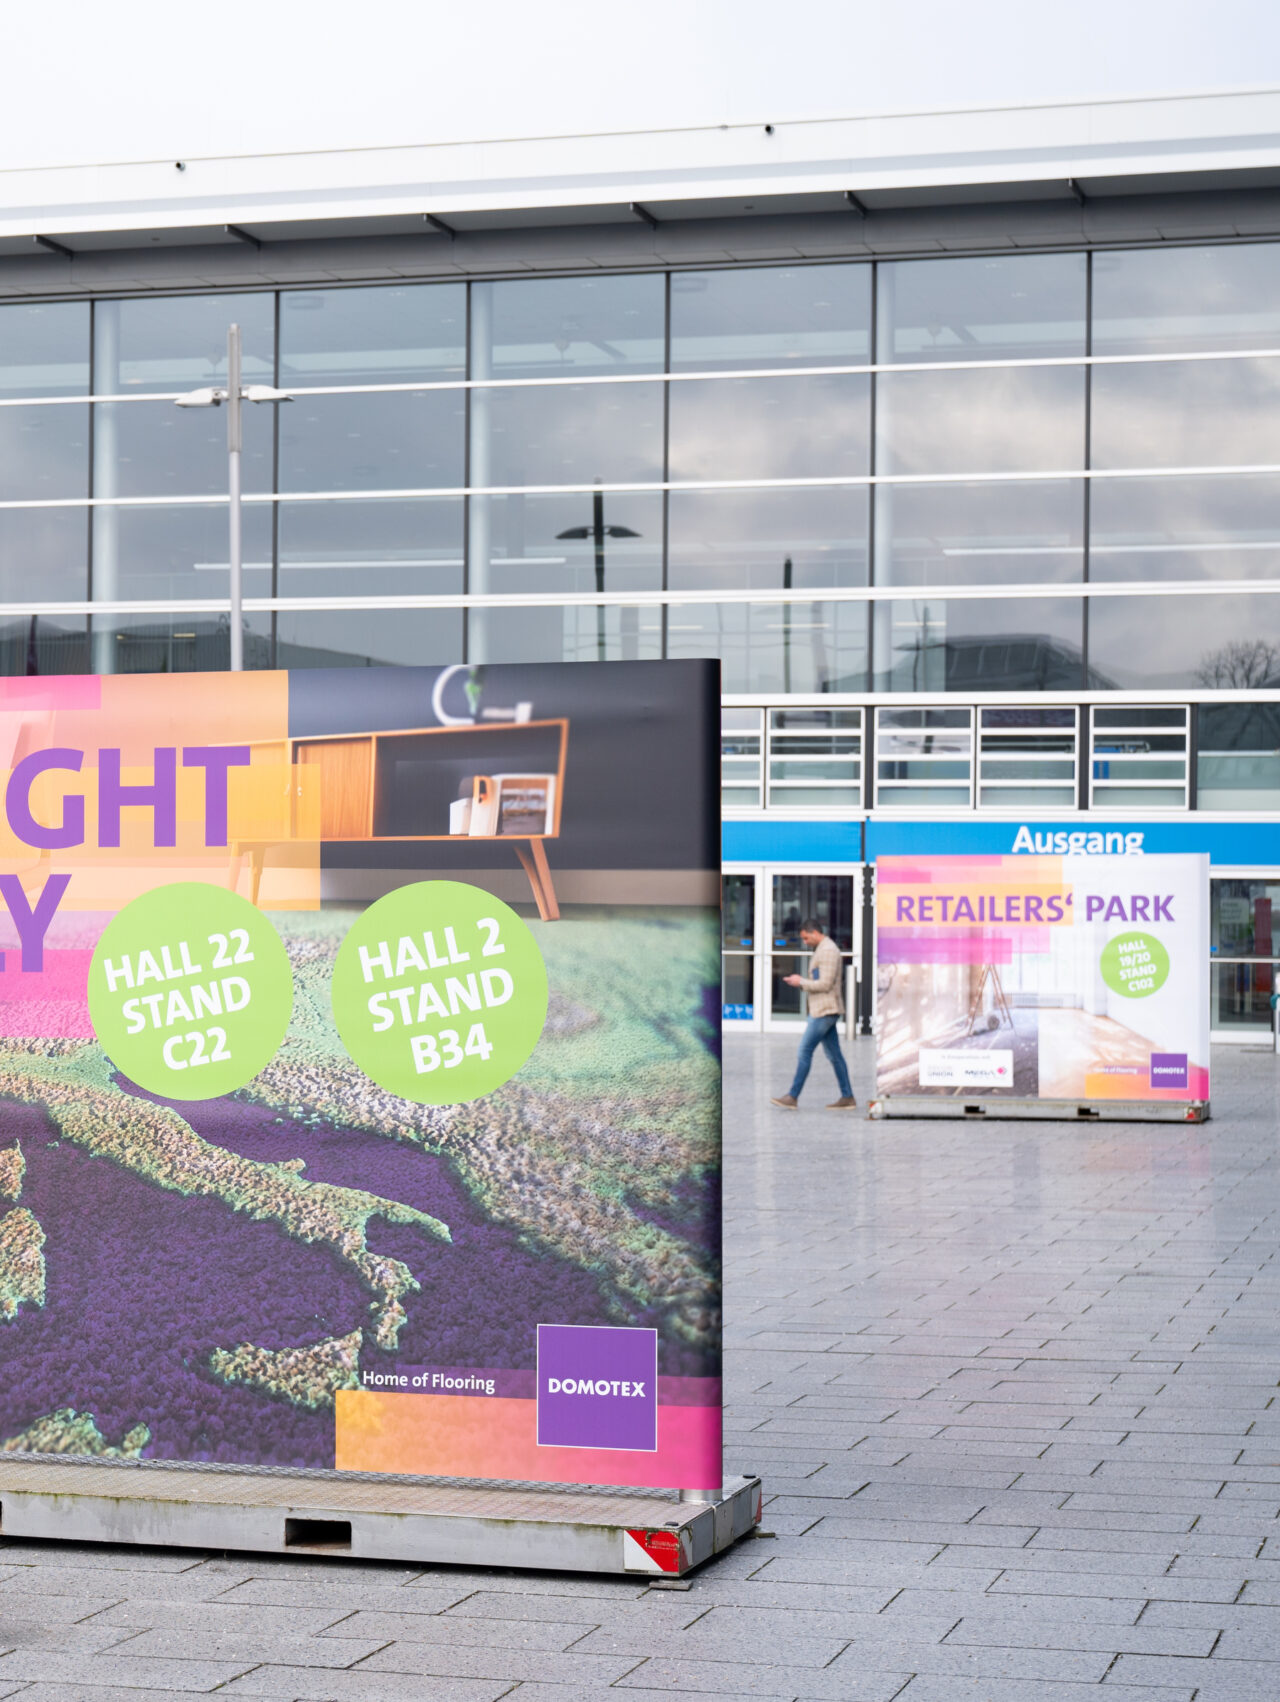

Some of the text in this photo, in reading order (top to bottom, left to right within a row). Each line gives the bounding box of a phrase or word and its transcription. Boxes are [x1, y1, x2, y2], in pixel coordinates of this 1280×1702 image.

[1012, 825, 1145, 855] Ausgang
[1086, 895, 1176, 922] PARK
[104, 928, 254, 992] HALL 22
[358, 917, 505, 982] HALL 2
[1118, 939, 1147, 954] HALL
[1119, 964, 1157, 981] STAND
[122, 976, 251, 1034] STAND
[367, 967, 514, 1032] STAND
[163, 1026, 231, 1070] C22
[410, 1022, 493, 1074] B34
[363, 1370, 495, 1394] Home of Flooring
[548, 1378, 646, 1397] DOMOTEX
